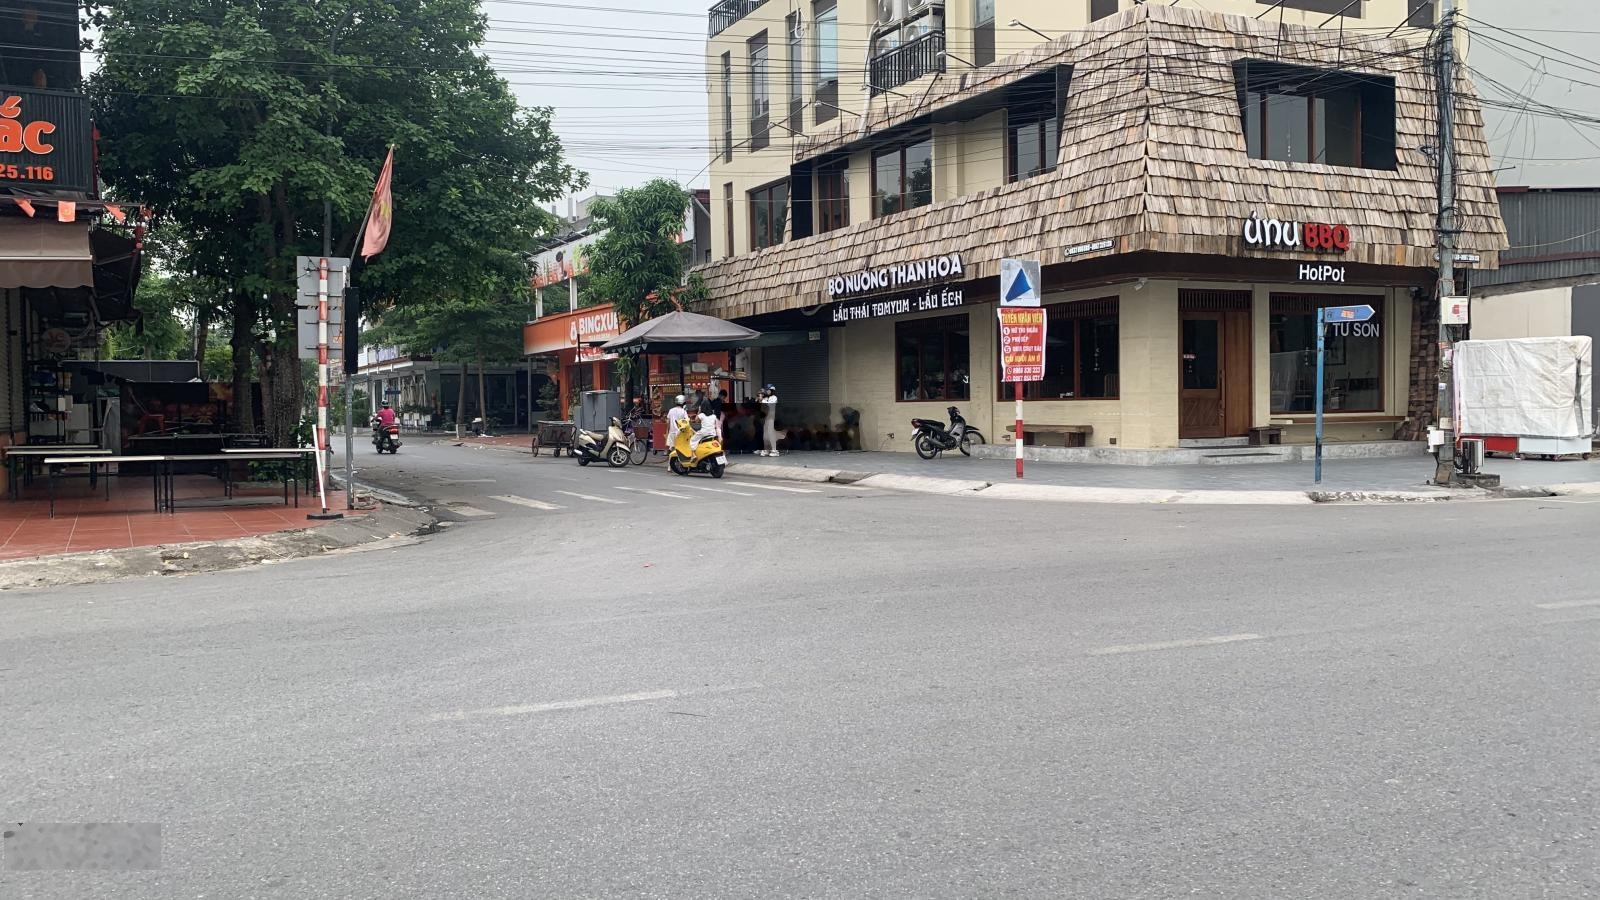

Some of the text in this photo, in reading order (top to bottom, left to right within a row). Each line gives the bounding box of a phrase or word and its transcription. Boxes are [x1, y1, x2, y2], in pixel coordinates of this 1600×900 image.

[1304, 222, 1350, 250] BBQ
[889, 261, 926, 286] THAN
[928, 252, 962, 279] HOA
[1299, 264, 1345, 282] HotPot
[850, 302, 870, 319] THÁI
[872, 298, 910, 317] TOMYUM
[941, 287, 963, 307] ẾCH
[579, 311, 618, 335] BINGXUE
[1353, 321, 1380, 338] SƠN
